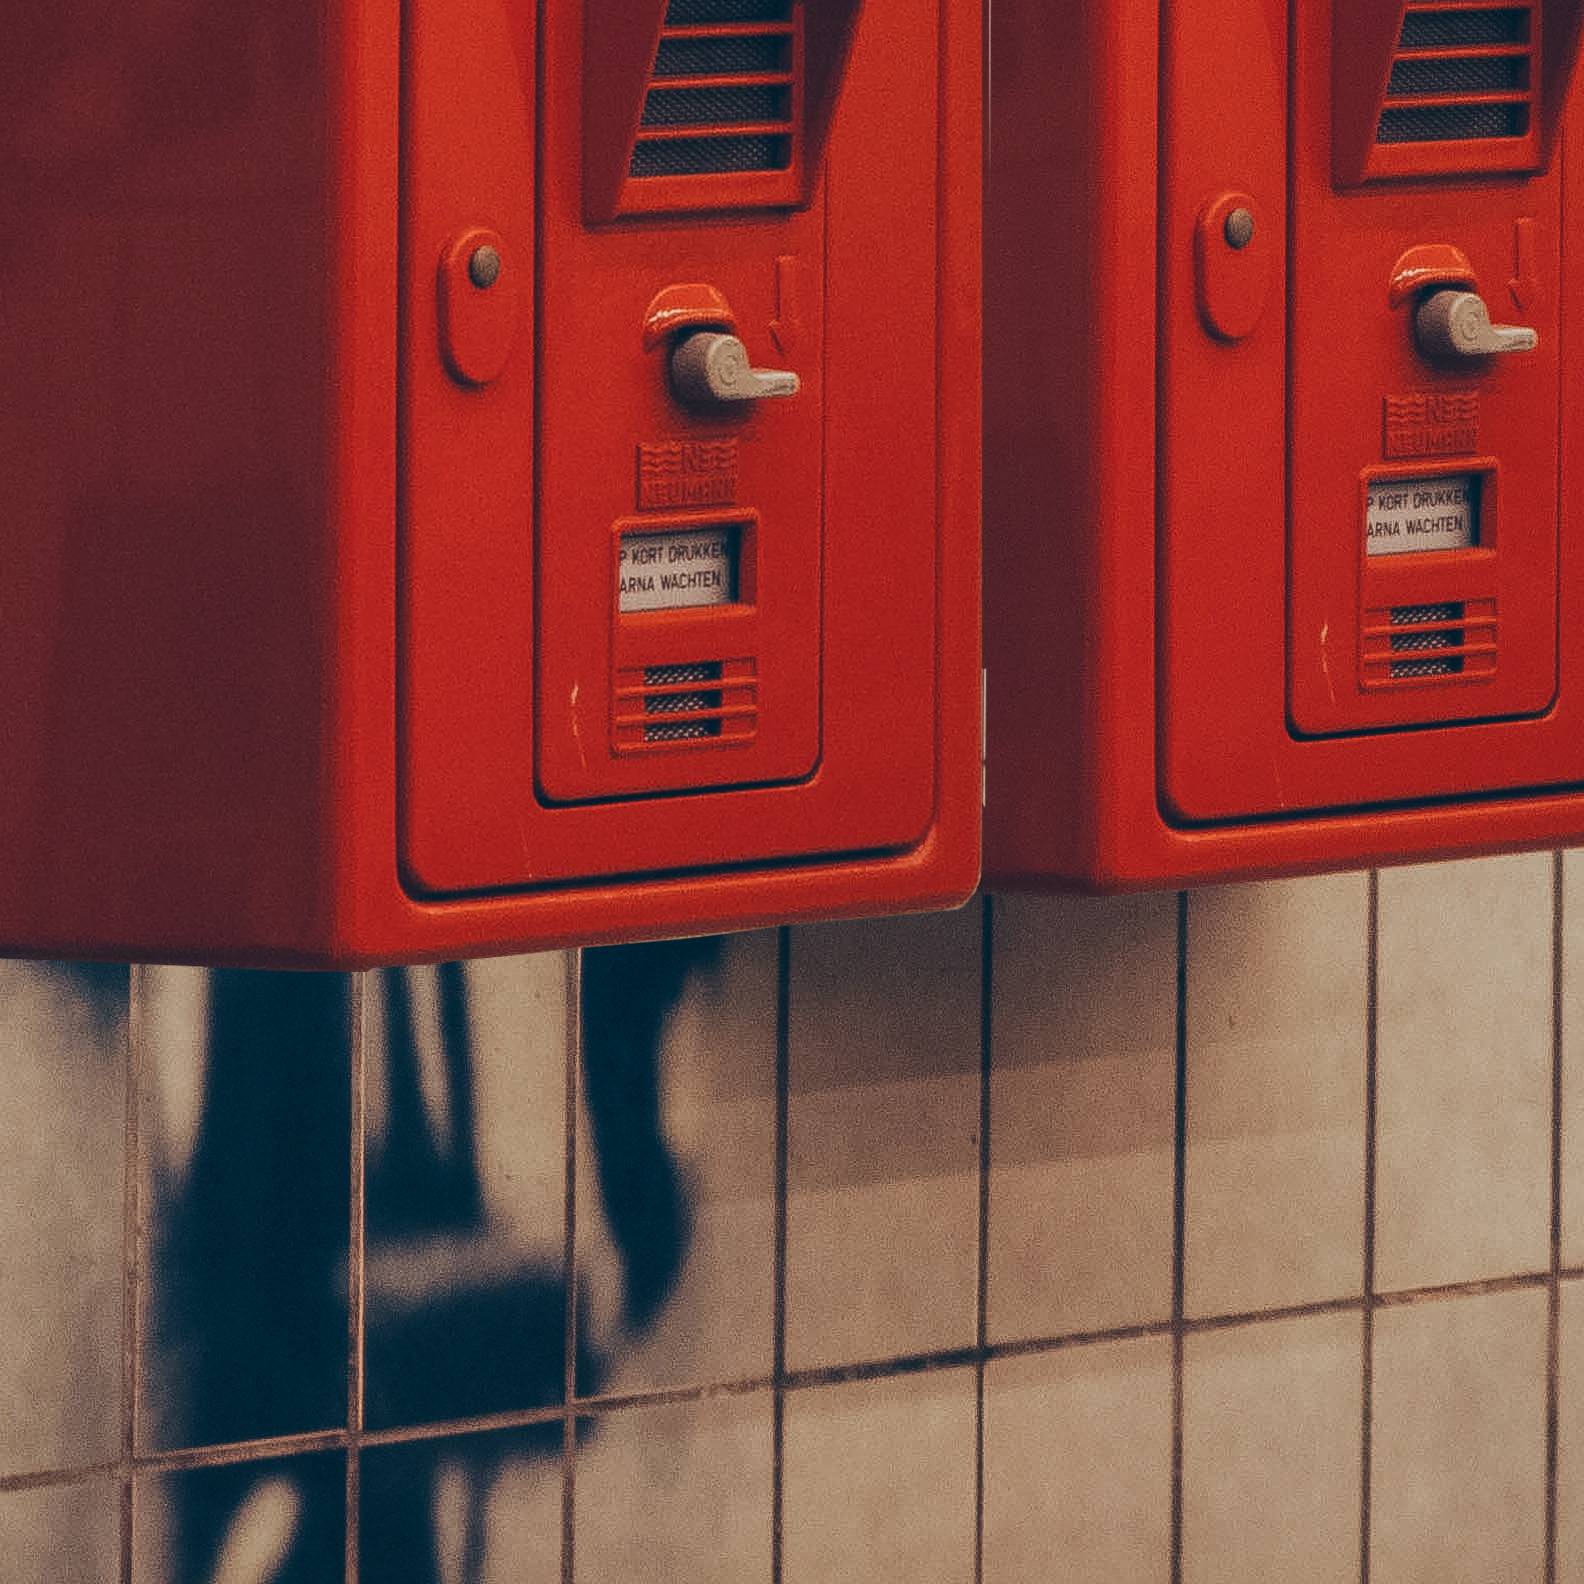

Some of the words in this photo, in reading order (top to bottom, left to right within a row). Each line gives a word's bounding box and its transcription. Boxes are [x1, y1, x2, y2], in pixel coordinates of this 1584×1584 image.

[1378, 493, 1409, 512] KORT
[1405, 515, 1464, 535] WACHTEN
[632, 545, 664, 565] KORT
[660, 570, 722, 591] WACHTEN
